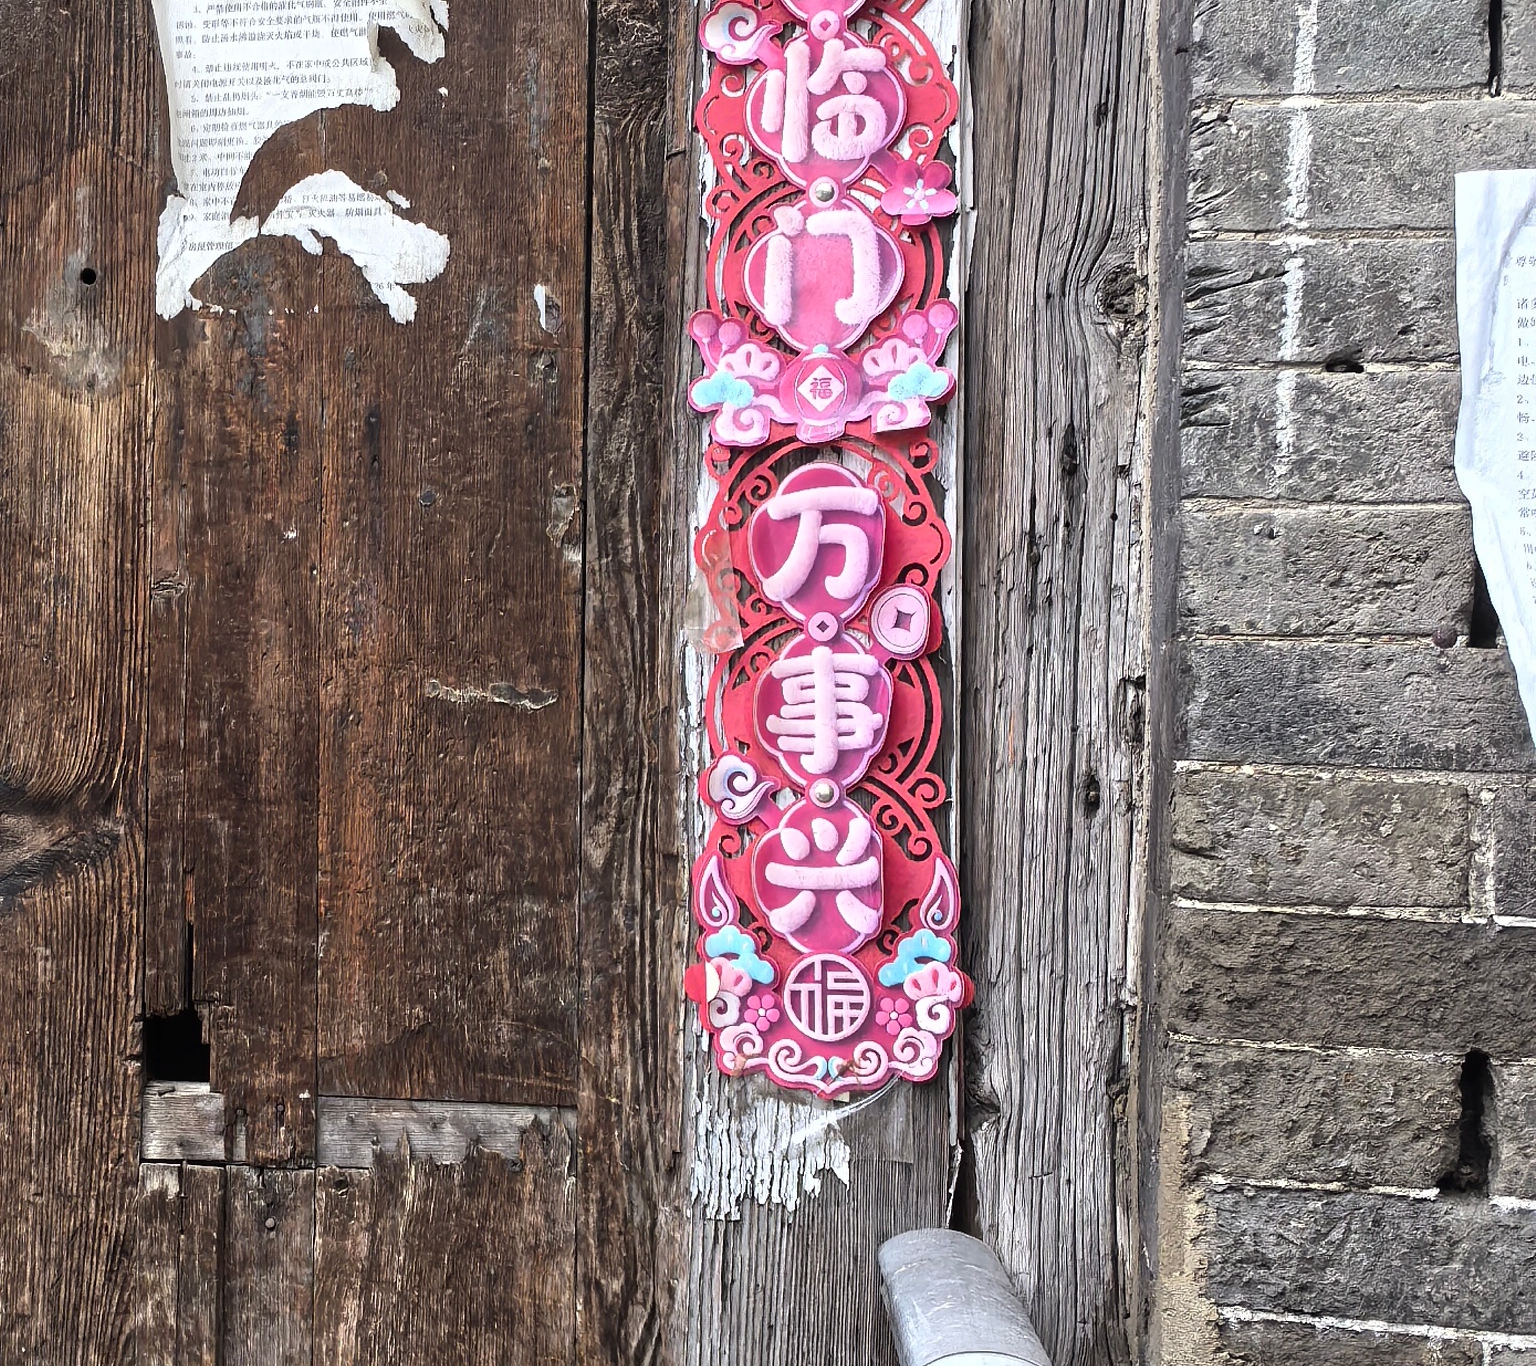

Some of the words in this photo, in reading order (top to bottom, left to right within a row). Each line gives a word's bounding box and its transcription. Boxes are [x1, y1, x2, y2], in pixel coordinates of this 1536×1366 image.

[810, 376, 834, 403] 福
[762, 485, 881, 938] 万事兴
